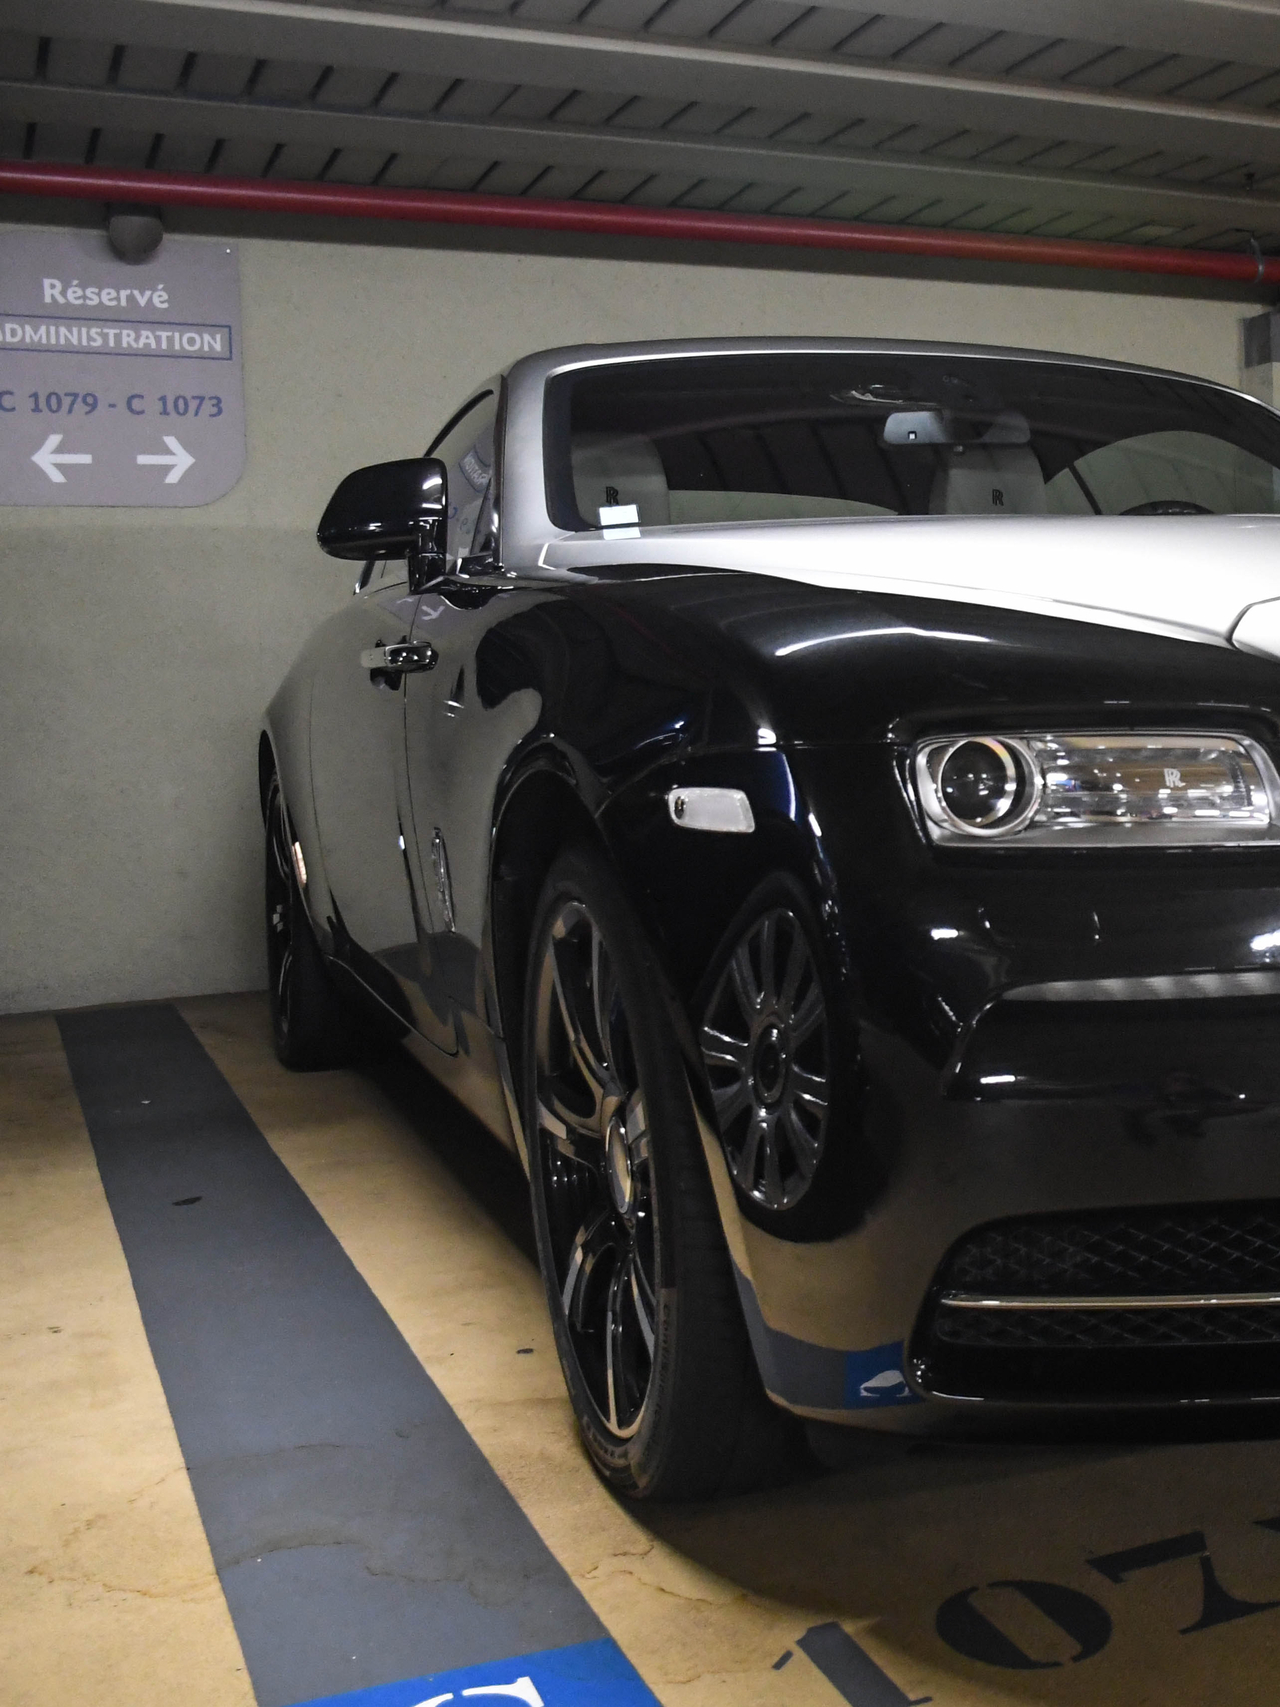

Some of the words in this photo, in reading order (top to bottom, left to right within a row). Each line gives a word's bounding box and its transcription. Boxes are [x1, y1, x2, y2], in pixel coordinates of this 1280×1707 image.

[42, 278, 169, 309] Réservé
[0, 322, 222, 352] DMINISTRATION
[0, 389, 17, 413] C
[28, 391, 99, 416] 1079
[126, 393, 146, 416] C
[157, 394, 224, 418] 1073
